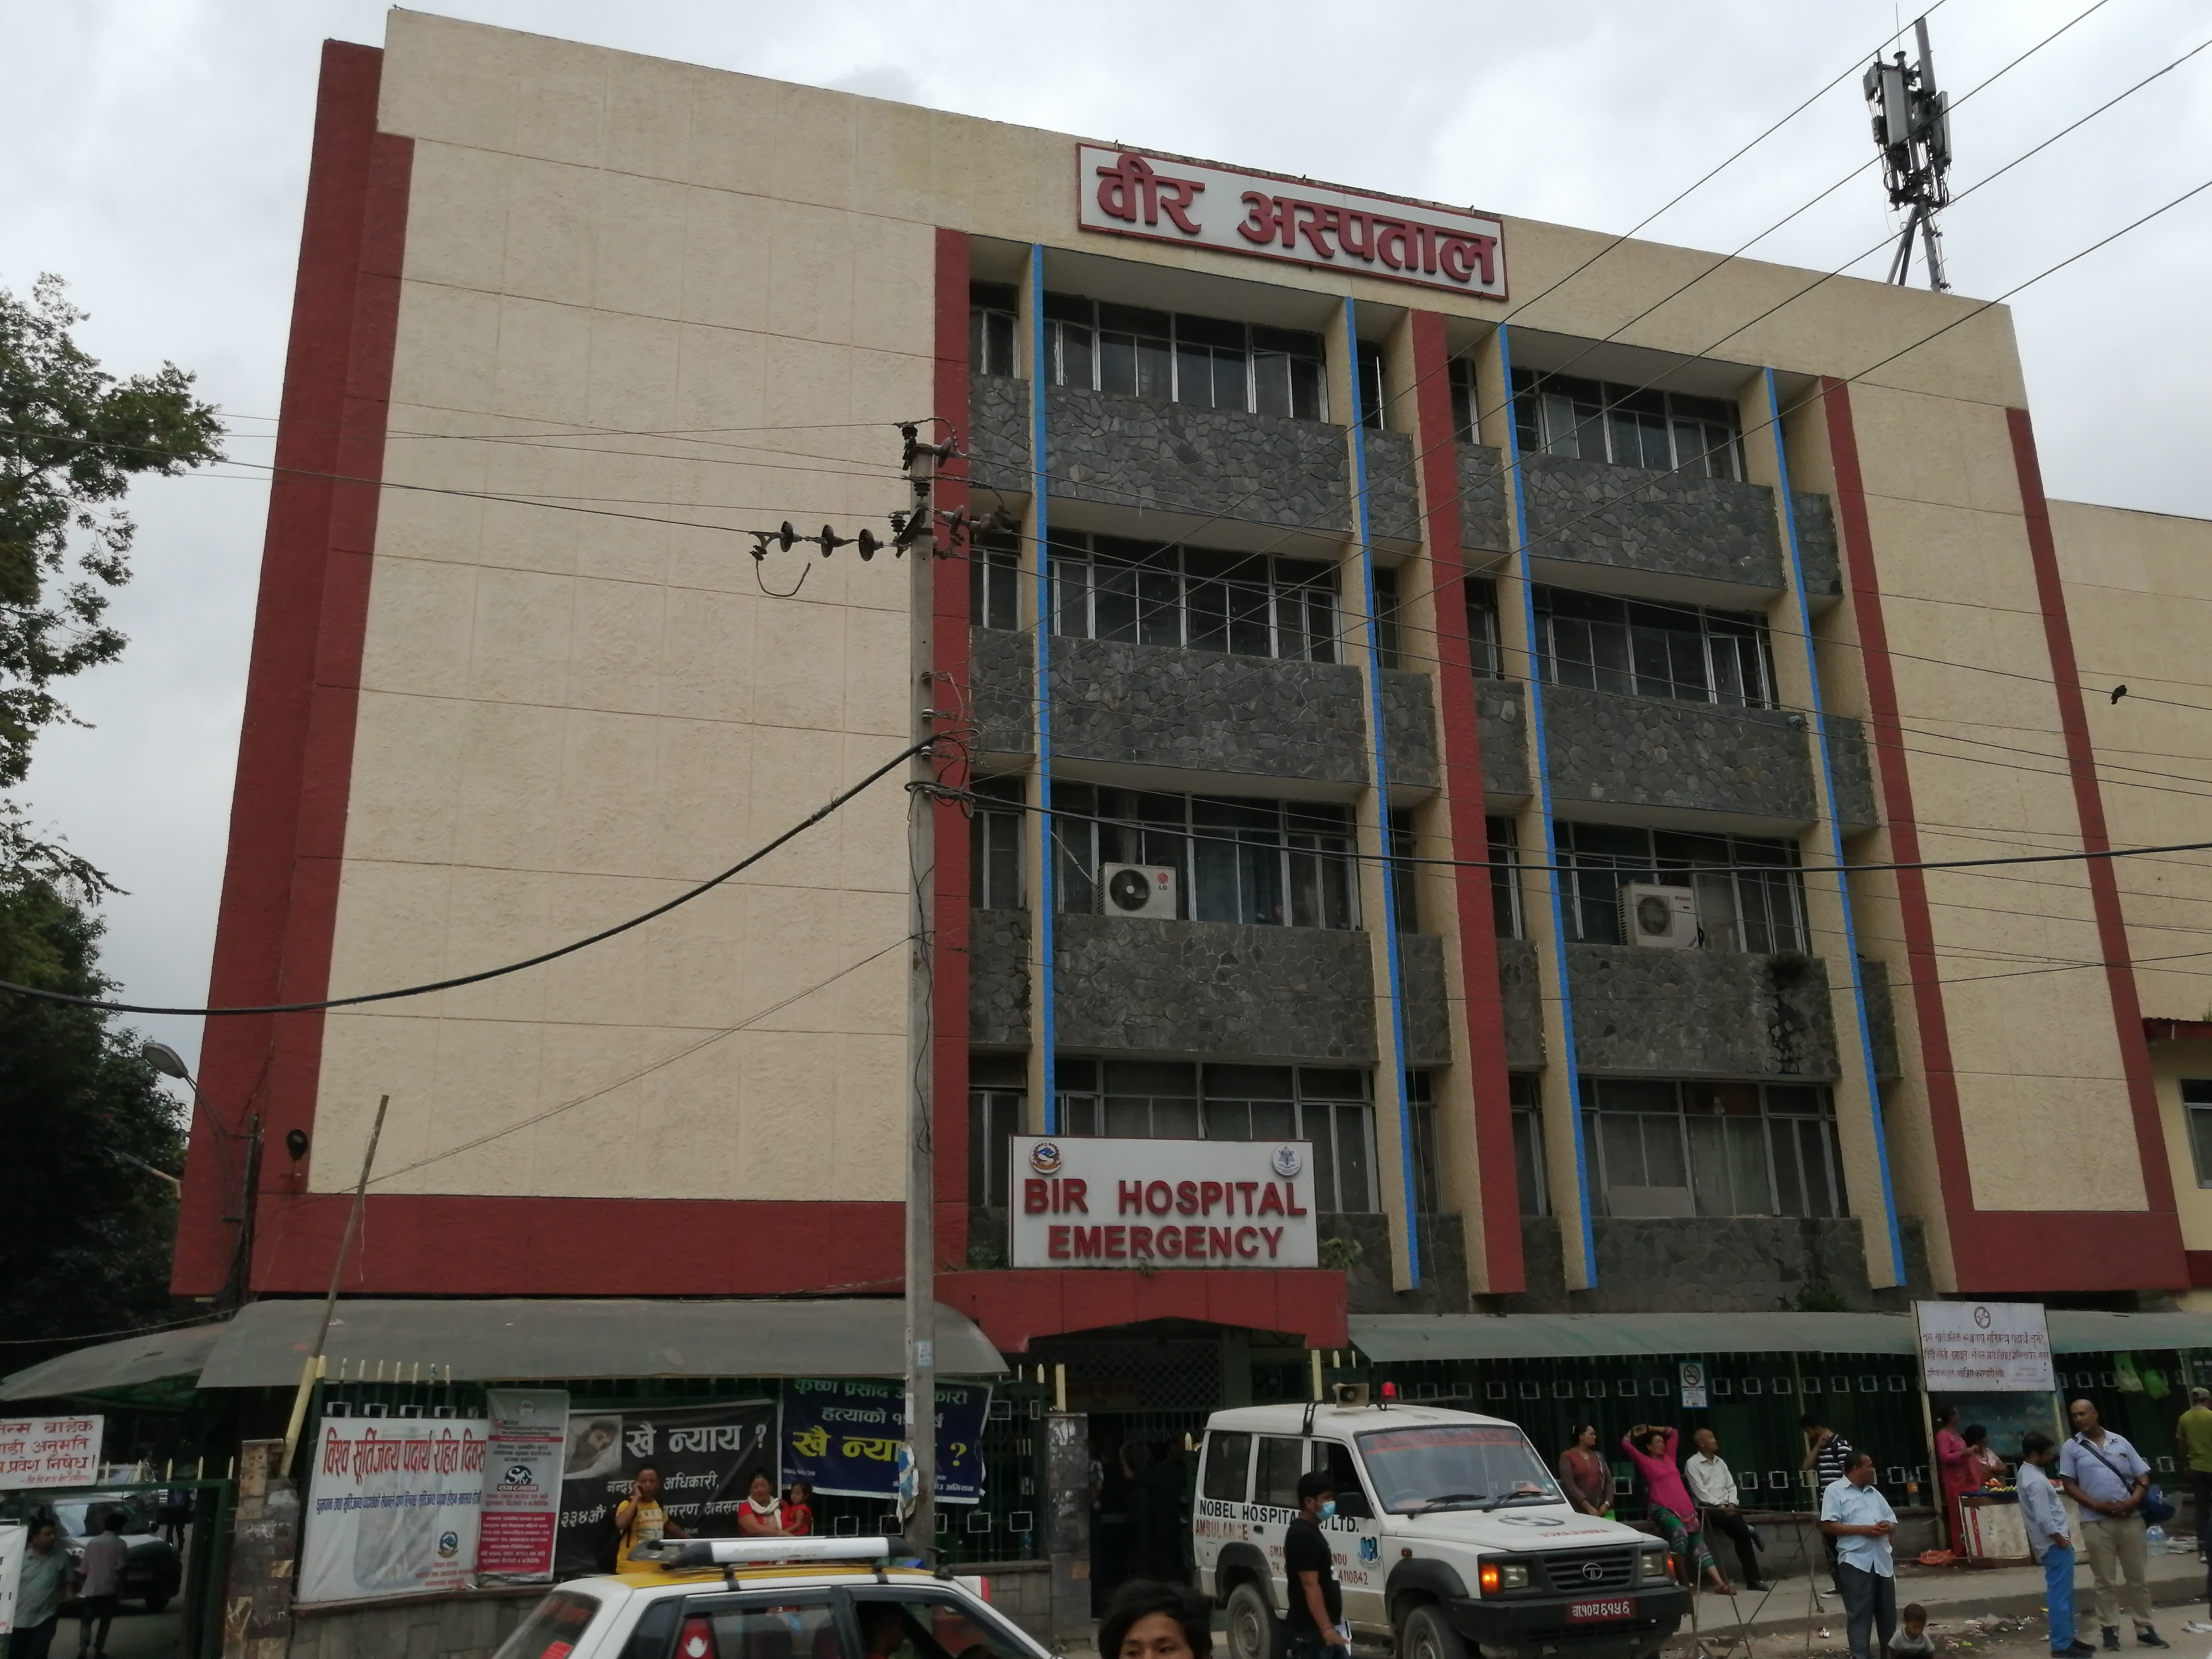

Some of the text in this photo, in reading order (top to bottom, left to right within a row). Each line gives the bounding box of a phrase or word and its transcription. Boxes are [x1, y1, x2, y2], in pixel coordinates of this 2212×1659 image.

[1096, 152, 1498, 284] वीर अस्पताल
[1024, 1178, 1307, 1216] BIR HOSPITAL
[1048, 1225, 1284, 1259] EMERGENCY
[822, 1407, 887, 1424] हत्याको
[31, 1434, 90, 1456] अनुमति
[323, 1426, 352, 1479] विश्व
[403, 1430, 434, 1476] पदार्थ
[434, 1427, 460, 1477] रहित
[626, 1421, 767, 1458] खै न्याय ?
[792, 1425, 967, 1467] खै न्या ?
[7, 1456, 41, 1474] प्रवेश
[663, 1502, 701, 1519] मरण
[1200, 1500, 1236, 1519] NOBEL
[1242, 1505, 1300, 1525] HOSPITA
[1332, 1516, 1360, 1533] LTD.
